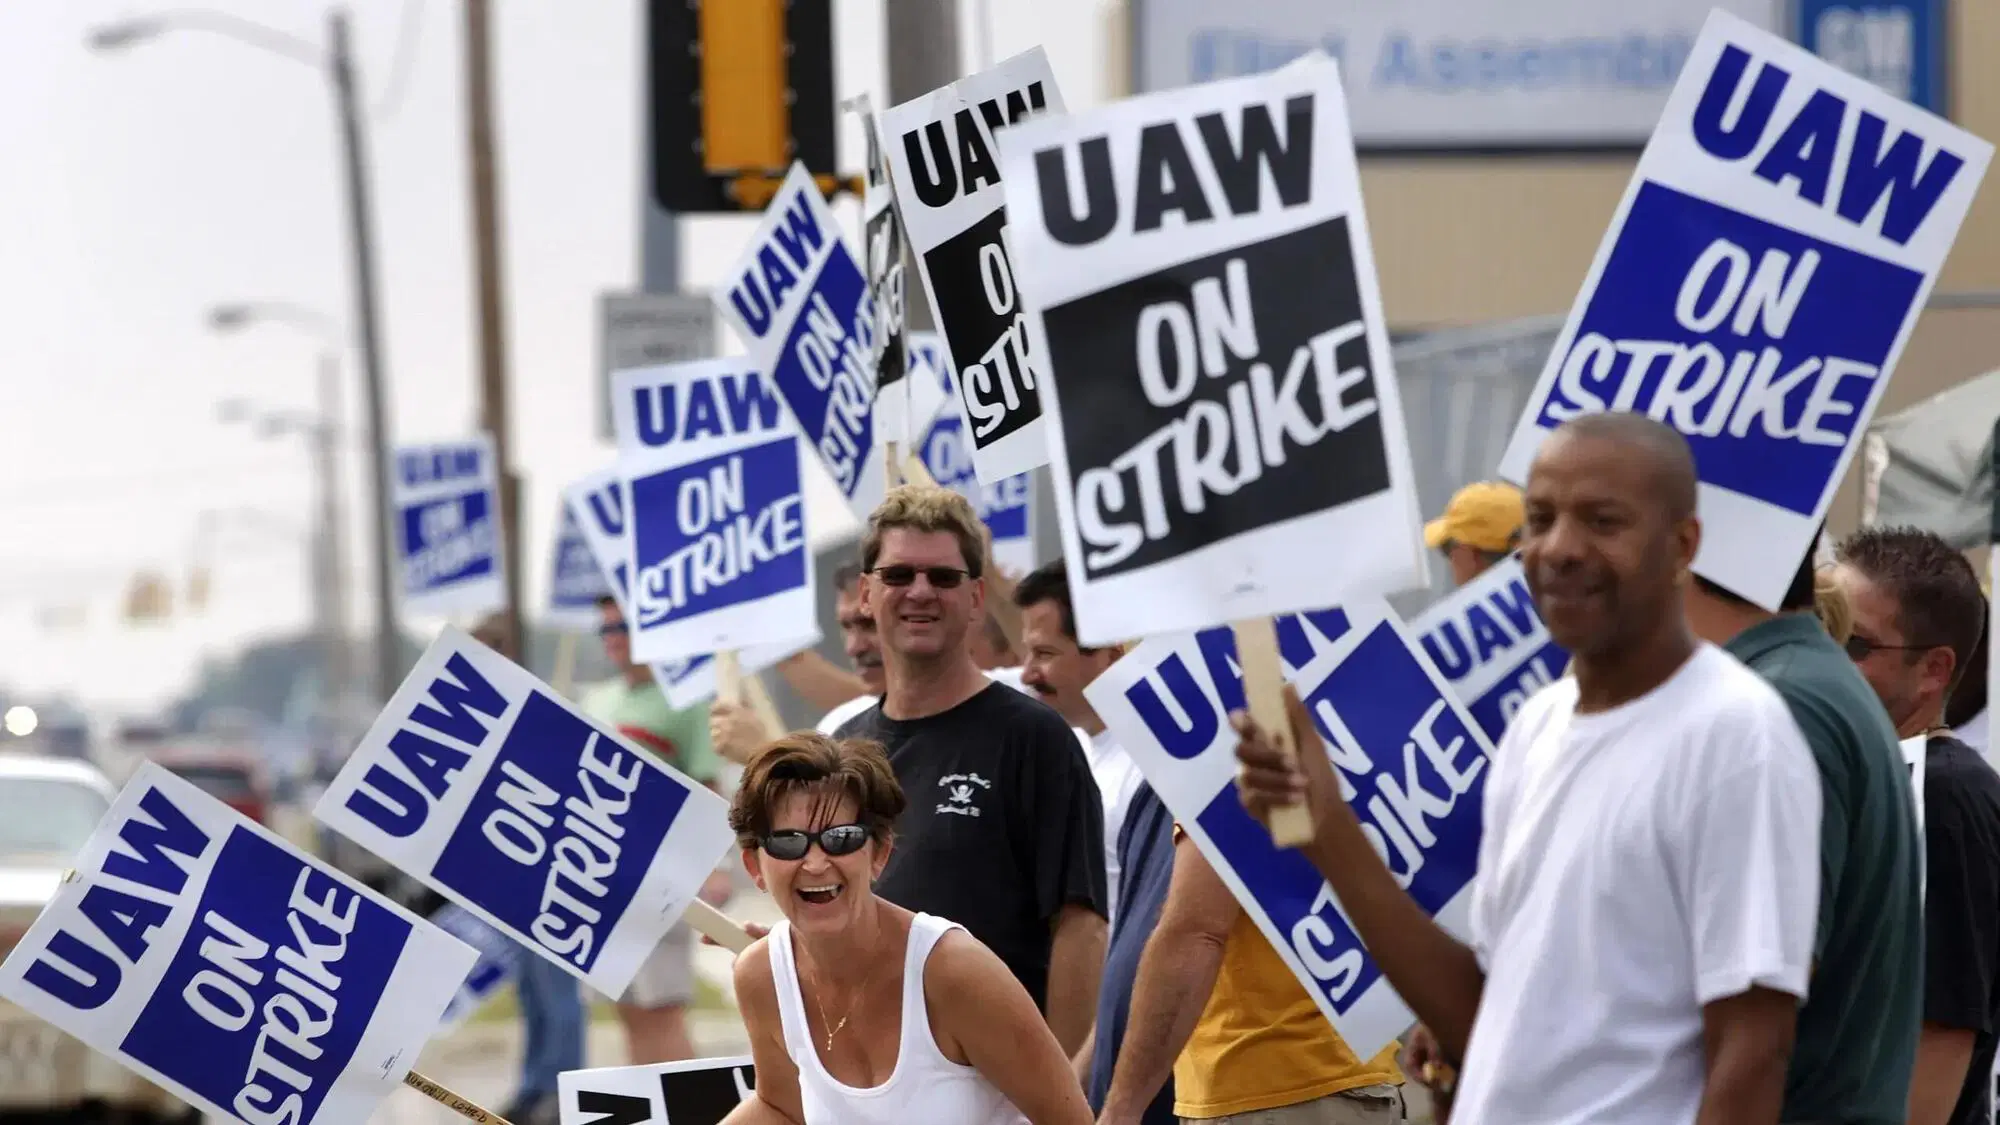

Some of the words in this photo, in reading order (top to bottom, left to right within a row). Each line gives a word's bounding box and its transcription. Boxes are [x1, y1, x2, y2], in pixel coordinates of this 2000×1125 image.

[1370, 31, 1690, 90] Assembl
[1034, 94, 1316, 246] UAW
[1692, 42, 1966, 247] UAW
[728, 188, 825, 339] UAW
[979, 224, 1016, 316] O
[1675, 237, 1821, 339] ON
[796, 290, 846, 392] ON
[962, 312, 1035, 439] STR
[1136, 258, 1260, 407] ON
[1548, 333, 1880, 447] STRIKE
[632, 371, 782, 448] UAW
[1076, 320, 1378, 570] STRIKE
[639, 494, 805, 624] STRIKE
[676, 455, 745, 537] ON
[344, 651, 510, 838] UAW
[1315, 698, 1374, 803] N
[481, 760, 561, 867] ON
[531, 731, 645, 966] STRIKE
[1291, 698, 1486, 1002] SIKE
[22, 786, 211, 1010] UAW
[182, 910, 270, 1032] ON
[233, 866, 361, 1125] STRIKE
